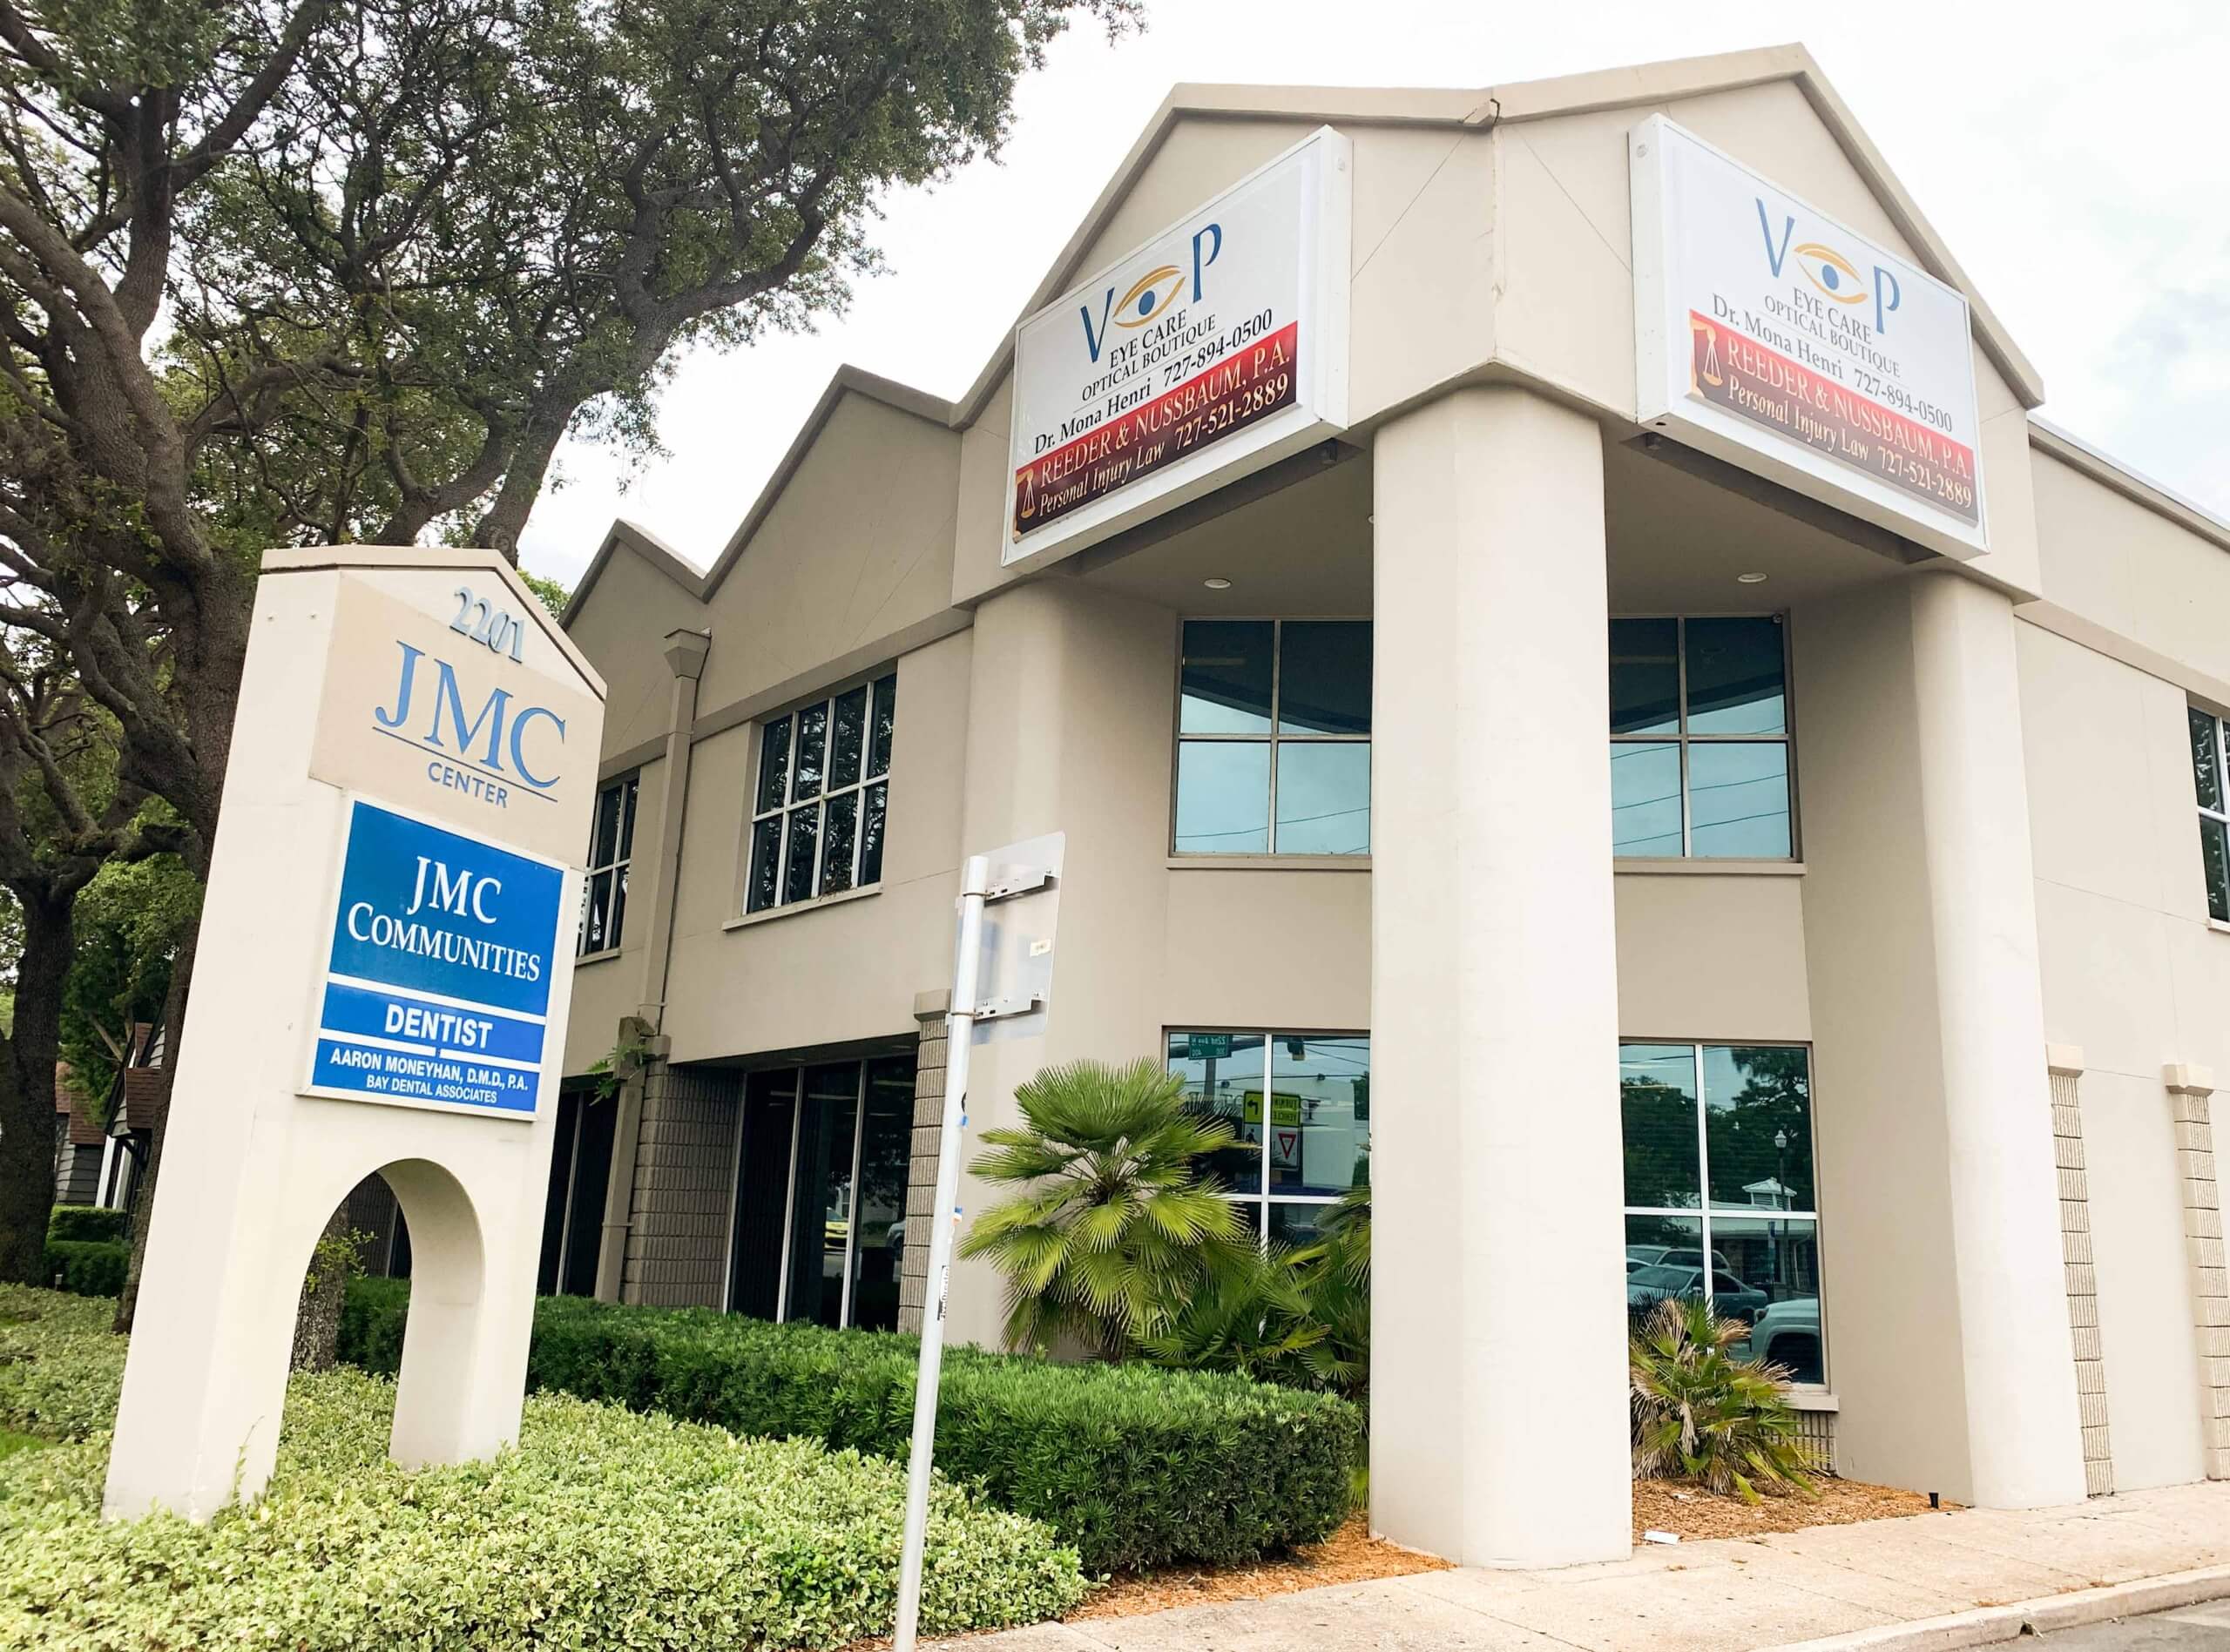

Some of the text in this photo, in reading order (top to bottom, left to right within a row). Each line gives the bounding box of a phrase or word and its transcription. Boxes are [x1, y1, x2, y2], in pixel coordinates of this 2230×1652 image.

[1109, 308, 1187, 369] EYE CARE
[1764, 295, 1901, 379] OPTICAL BOUTIQUE
[1793, 287, 1872, 345] EYE CARE
[1034, 307, 1273, 455] Dr. Mona Henri 727-894-0500
[1081, 314, 1216, 402] OPTICAL BOUTIQUE
[1713, 293, 1952, 434] Dr. Mona Henri 727-894-0500
[1038, 373, 1289, 518] Personal Injury Law 727-521-2889
[1040, 338, 1291, 488] REEDER & NUSSBAUM, P.A.
[1727, 337, 1972, 481] REEDER & NUSSBAUM, P.A.
[1727, 374, 1973, 509] Personal Injury Law 727-521-2889
[449, 585, 525, 664] 2201
[374, 640, 566, 789] JMC
[427, 761, 509, 809] CENTER
[406, 855, 503, 925] JMC
[348, 900, 542, 982] COMMUNITIES
[384, 1002, 494, 1049] DENTIST
[329, 1047, 383, 1070] AARON
[384, 1057, 464, 1086] MONEYHAN,
[507, 1073, 530, 1091] P.A.
[366, 1074, 498, 1104] BAY DENTAL ASSOCIATES
